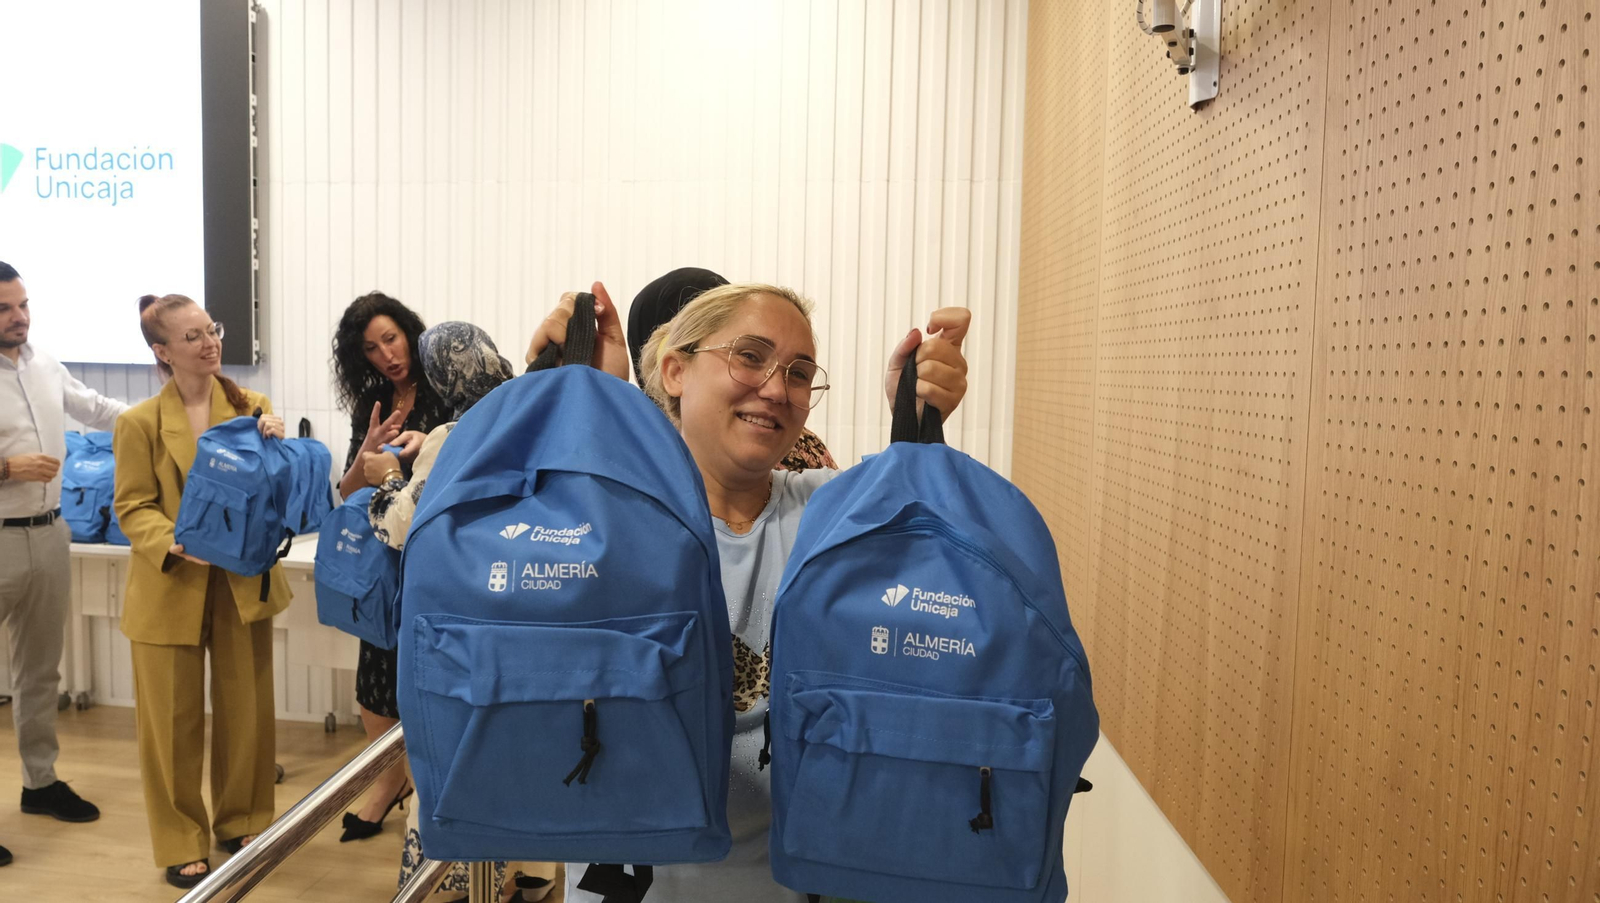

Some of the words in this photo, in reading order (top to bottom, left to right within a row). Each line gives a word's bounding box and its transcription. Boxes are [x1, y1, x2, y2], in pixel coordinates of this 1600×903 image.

[35, 145, 174, 171] Fundación
[35, 174, 134, 206] Unicaja
[530, 532, 581, 546] Unicaja
[533, 522, 593, 537] Fundación
[521, 560, 599, 579] ALMERÍA
[520, 579, 562, 590] CIUDAD
[912, 587, 976, 608] Fundación
[910, 598, 959, 619] Unicaja
[902, 646, 940, 661] CIUDAD
[903, 632, 976, 657] ALMERÍA
